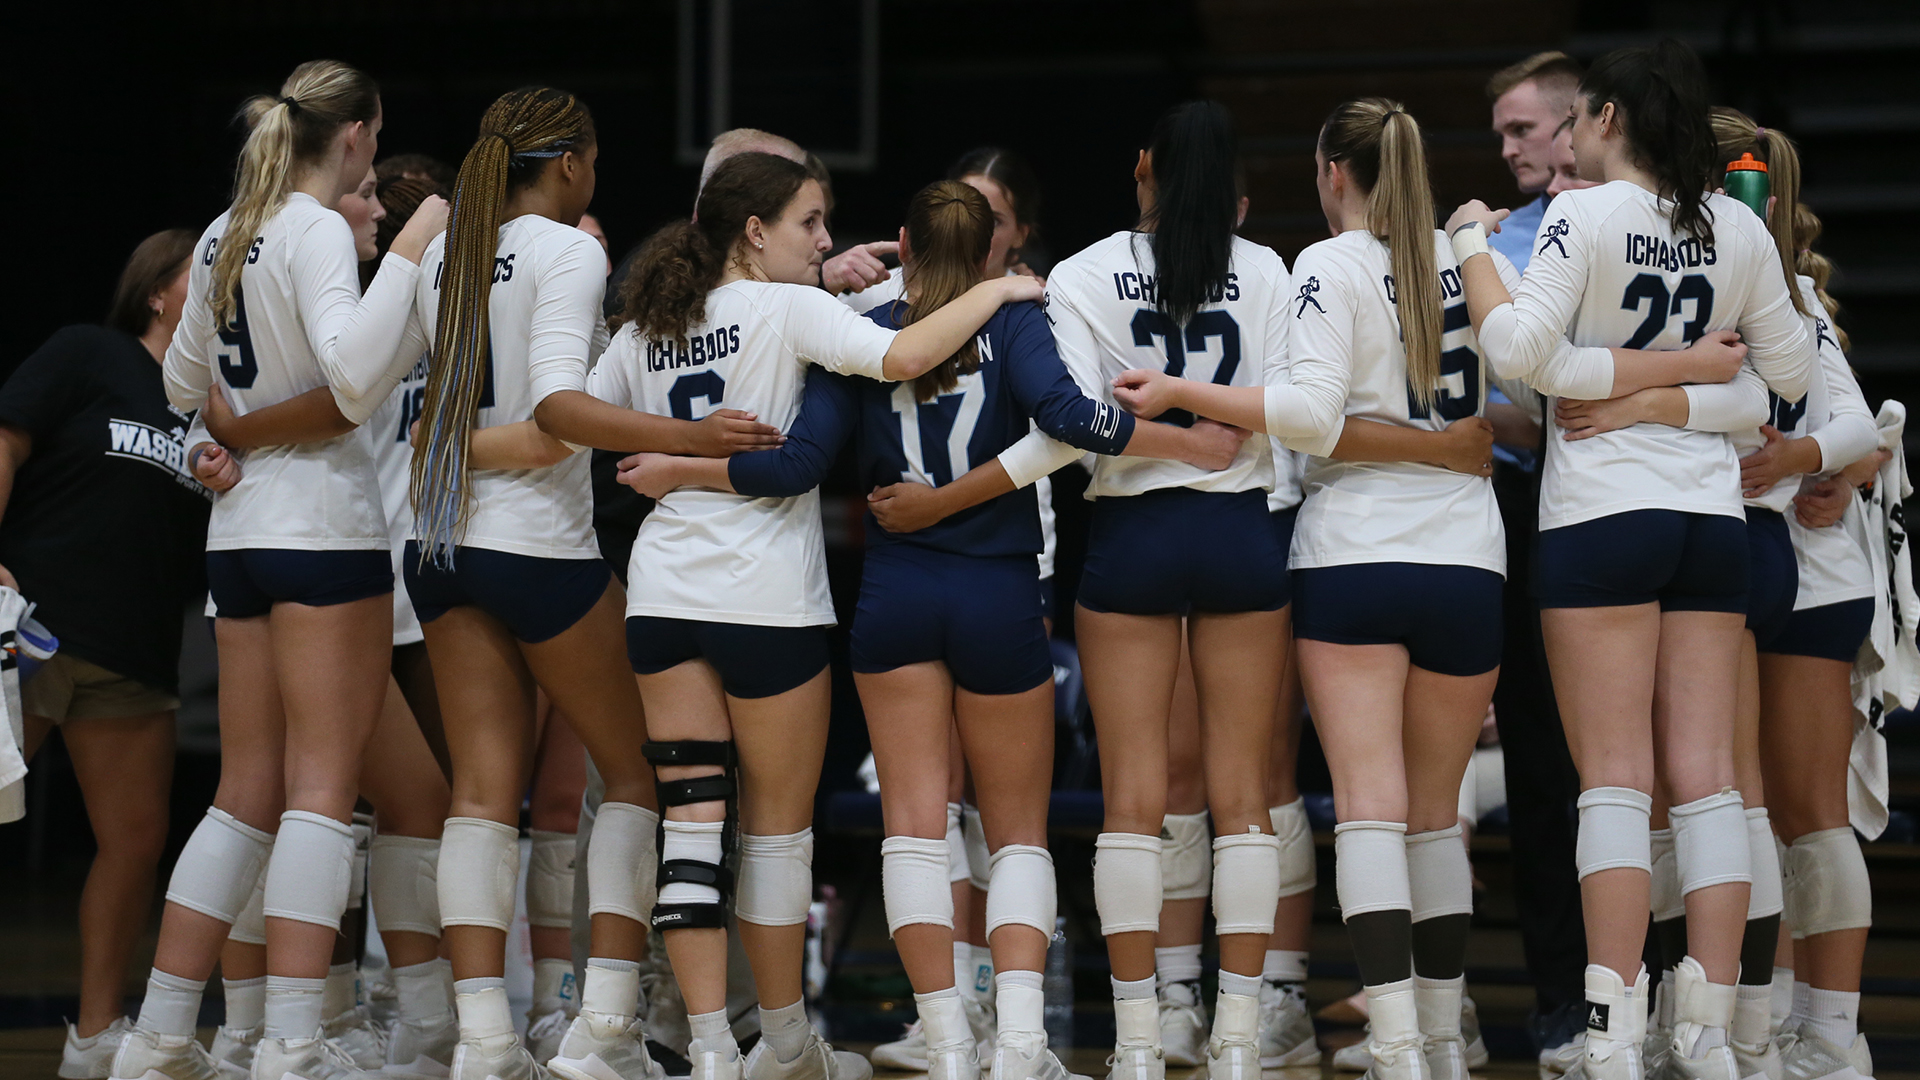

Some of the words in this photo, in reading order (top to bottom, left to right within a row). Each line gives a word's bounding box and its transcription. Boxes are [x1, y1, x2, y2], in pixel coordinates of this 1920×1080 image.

[1626, 233, 1717, 272] ICHABODS
[1113, 272, 1241, 304] ICHDS
[1620, 272, 1715, 351] 23
[213, 277, 259, 389] 9
[647, 324, 740, 372] ICHABODS
[890, 370, 987, 488] 17
